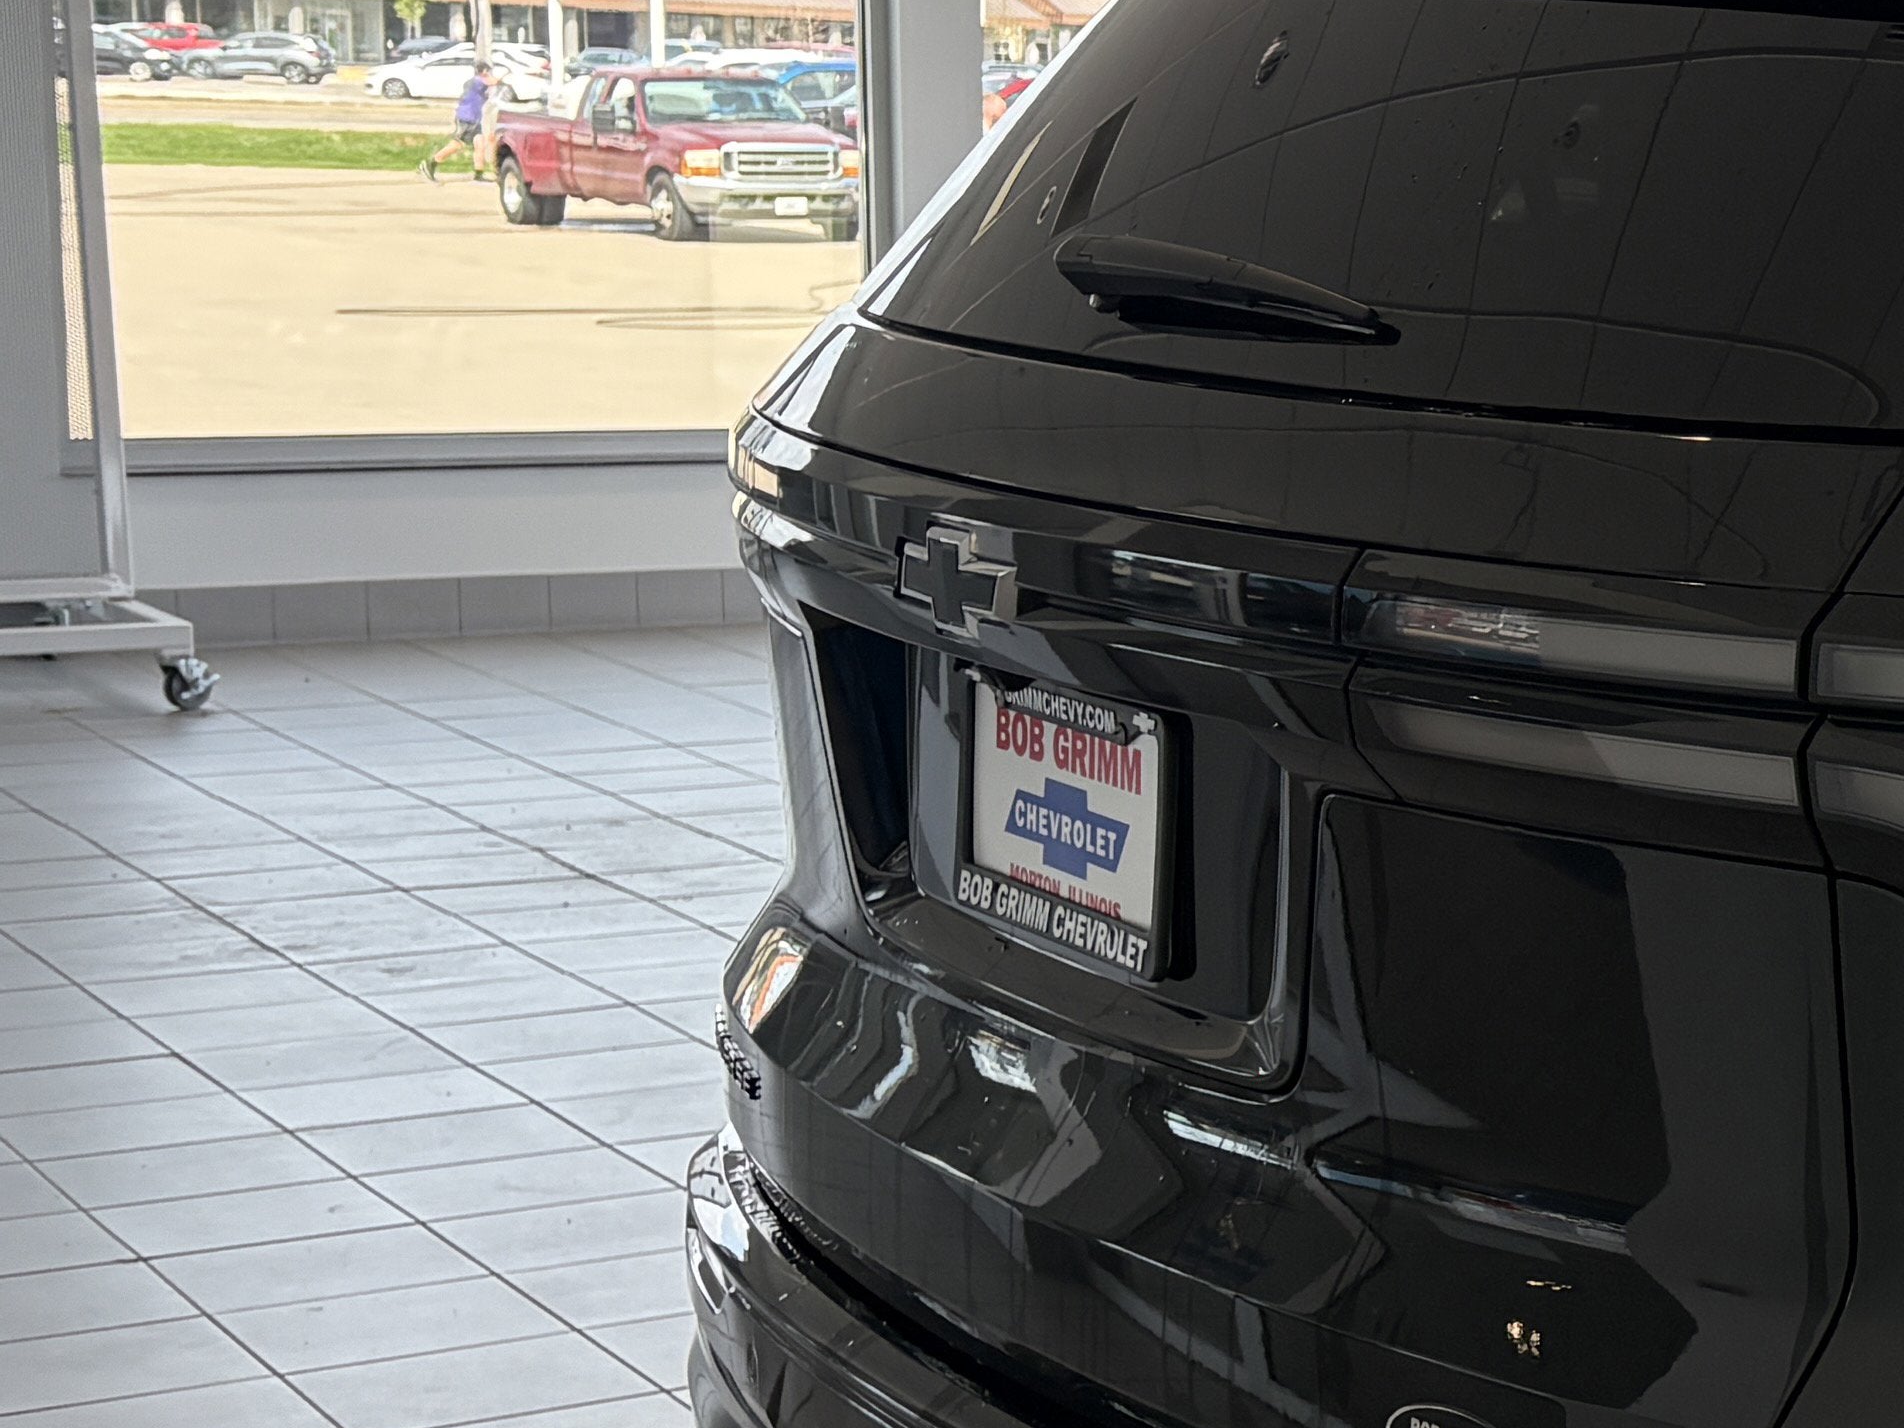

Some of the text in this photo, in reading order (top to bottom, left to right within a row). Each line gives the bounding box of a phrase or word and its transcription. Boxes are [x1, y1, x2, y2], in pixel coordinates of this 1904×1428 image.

[996, 706, 1142, 796] BOB GRIMM
[1014, 799, 1118, 860] CHEVROLET
[957, 869, 1148, 973] BOB GRIMM CHEVROLET
